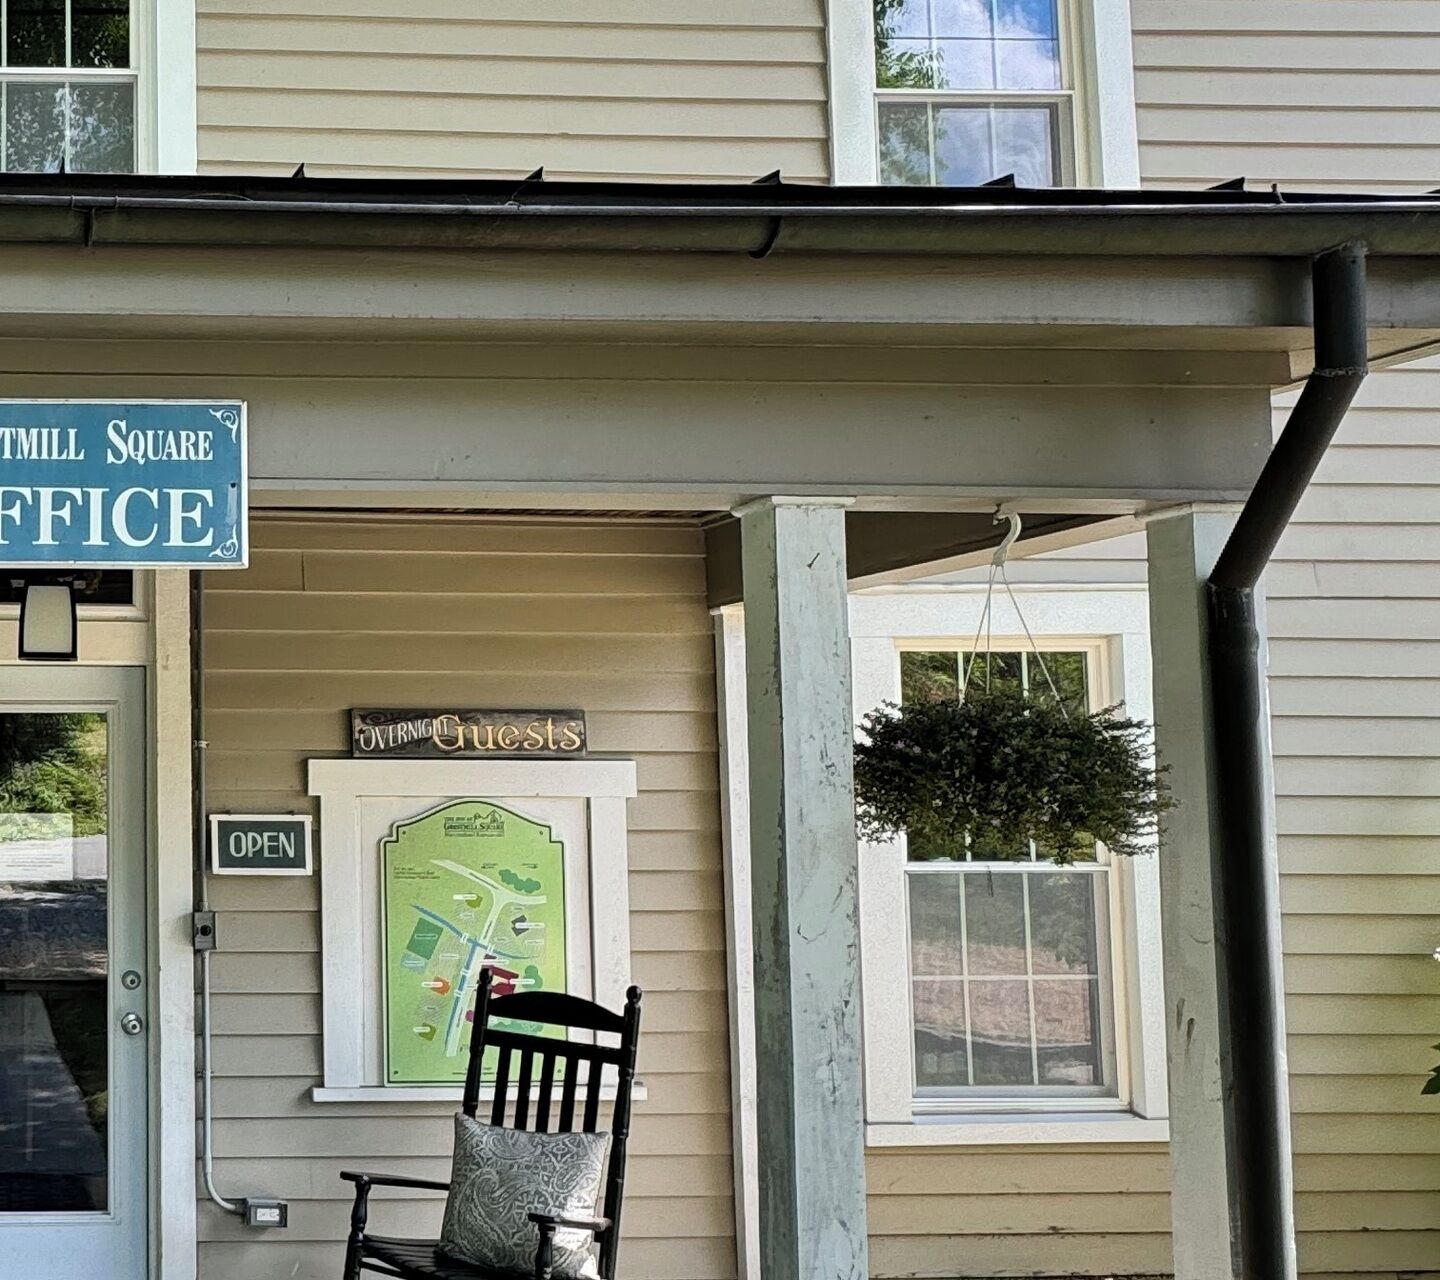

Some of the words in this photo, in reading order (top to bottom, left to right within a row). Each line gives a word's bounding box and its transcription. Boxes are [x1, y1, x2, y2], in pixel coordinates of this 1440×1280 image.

[106, 419, 214, 465] SQUARE
[360, 718, 449, 751] OVERNIGHT
[432, 714, 581, 751] Guests
[229, 831, 295, 859] OPEN
